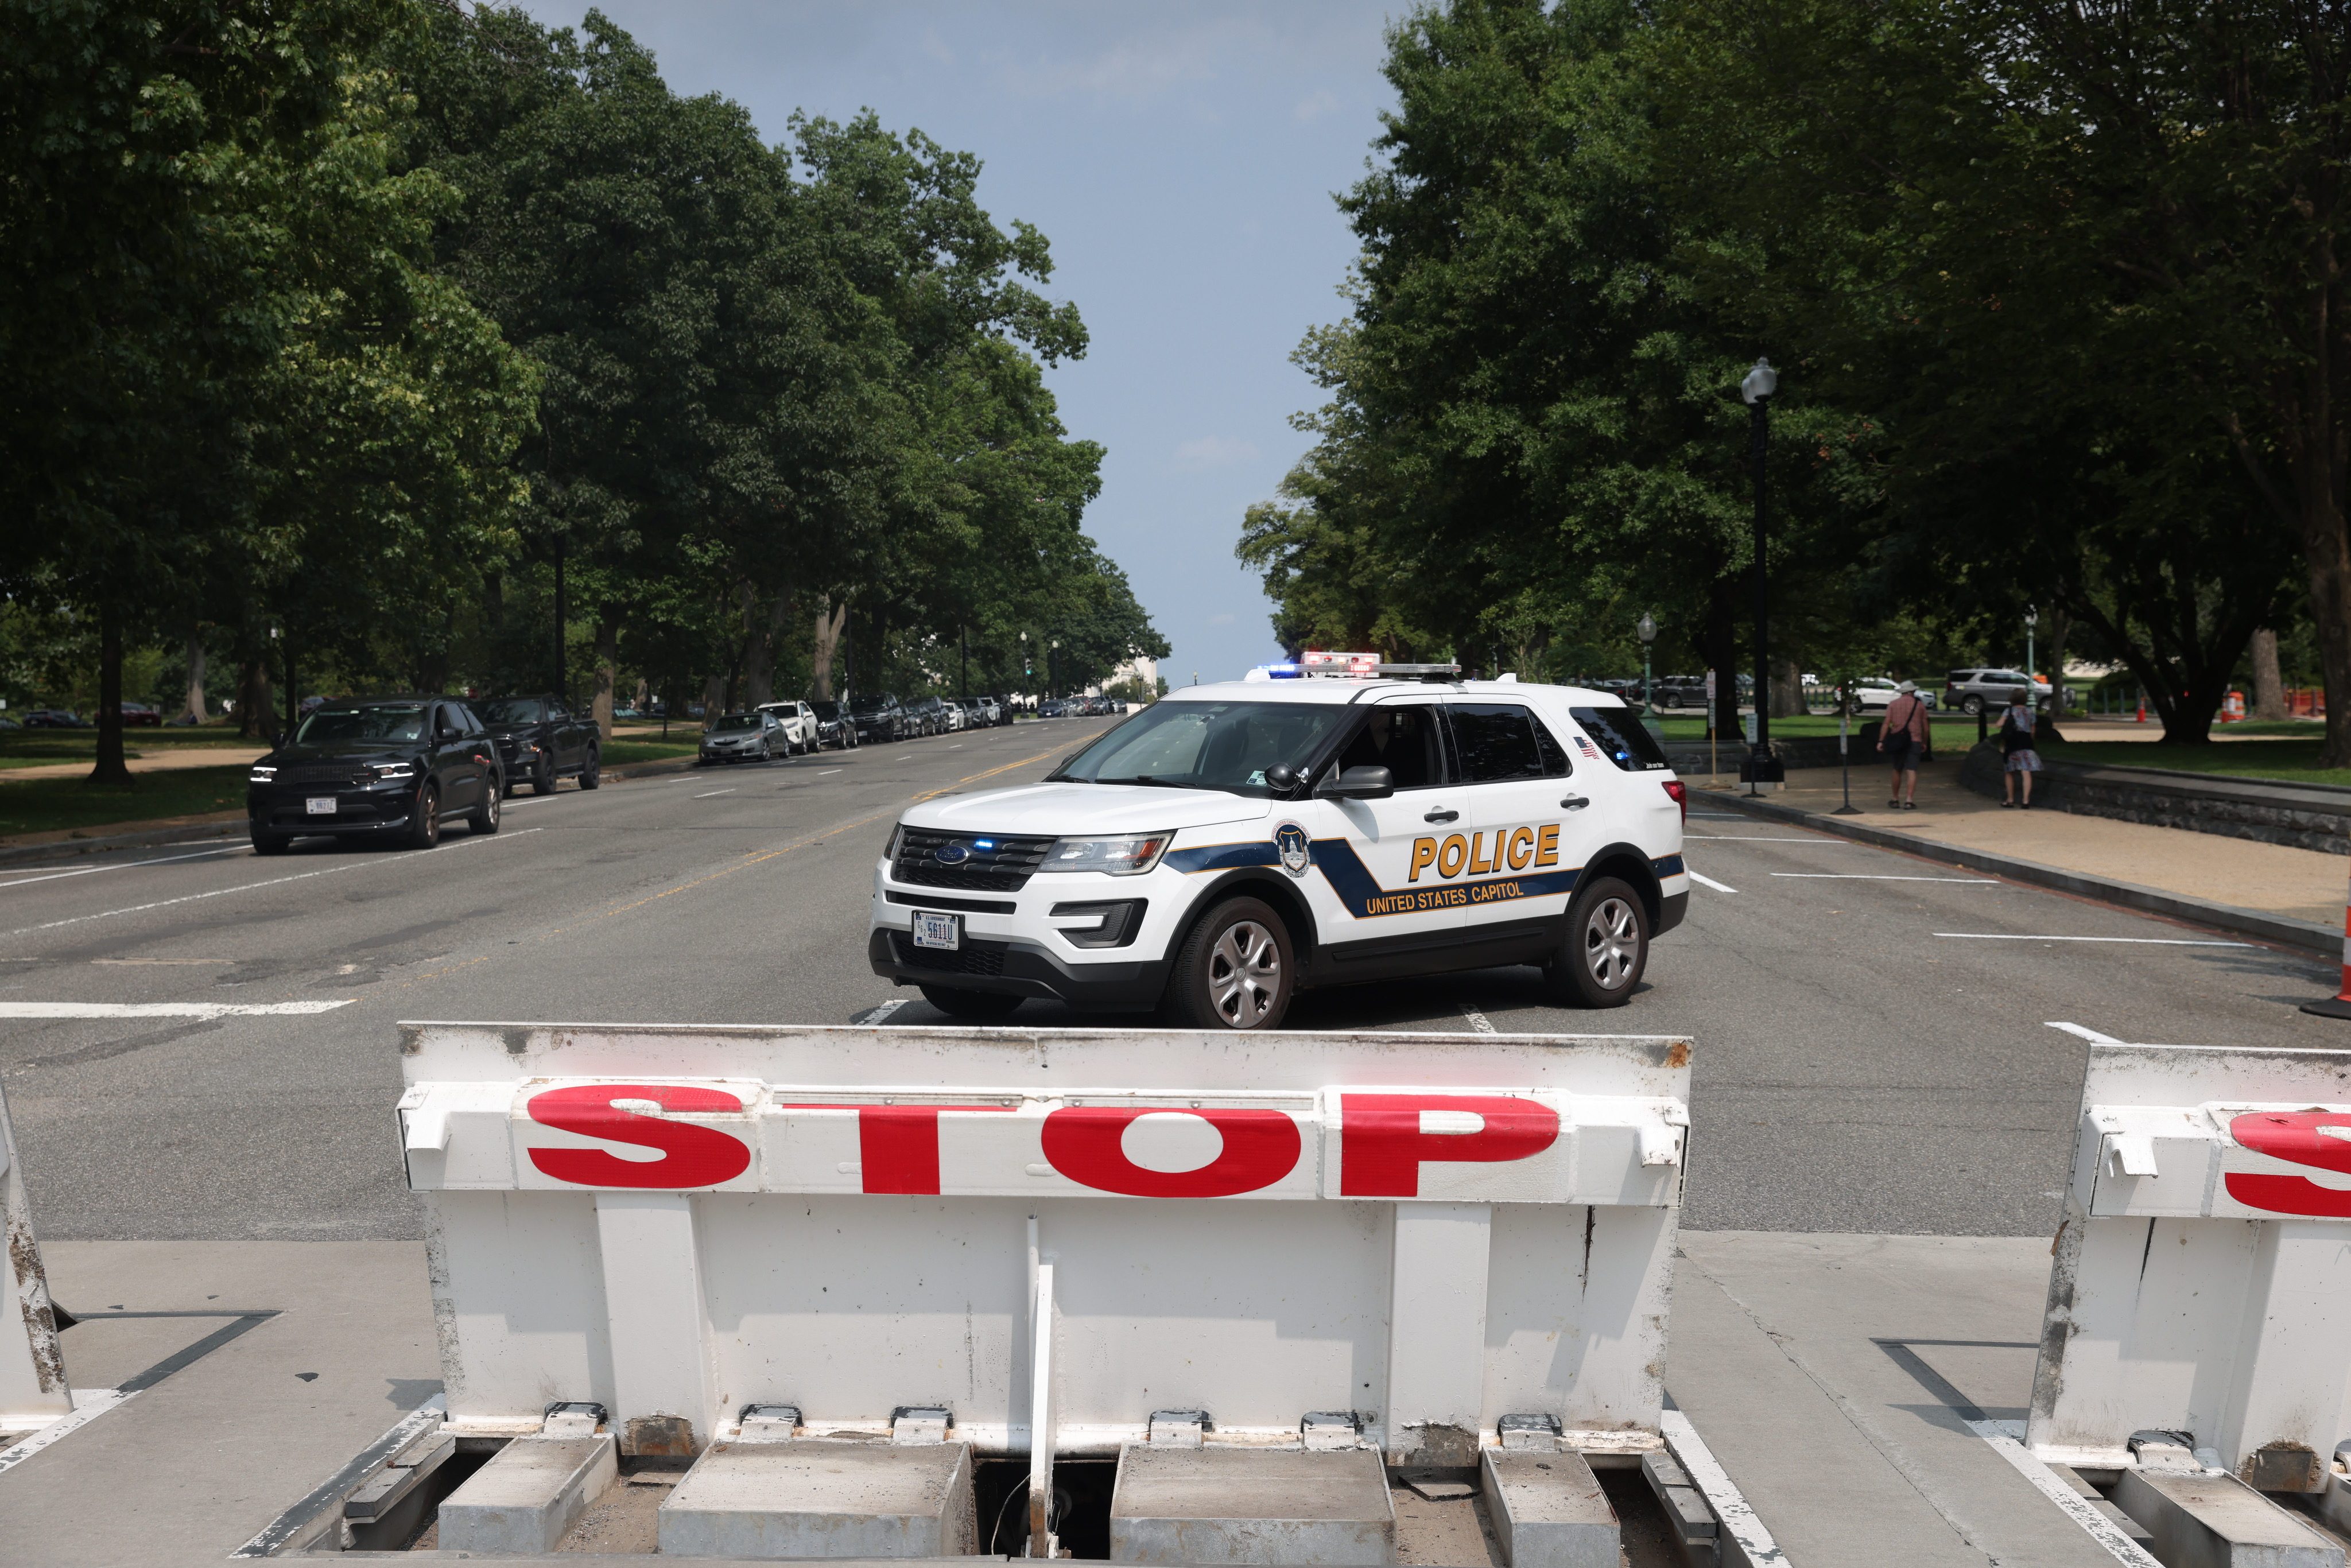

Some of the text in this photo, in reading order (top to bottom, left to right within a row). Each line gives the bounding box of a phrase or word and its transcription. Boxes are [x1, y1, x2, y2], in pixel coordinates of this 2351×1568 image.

[1276, 821, 1286, 829] STATES
[1301, 826, 1312, 839] POLICE
[1408, 824, 1560, 883] POLICE
[1366, 882, 1524, 914] UNITED STATES CAPITOL
[928, 922, 952, 940] 5611U
[527, 1084, 1559, 1198] STOP
